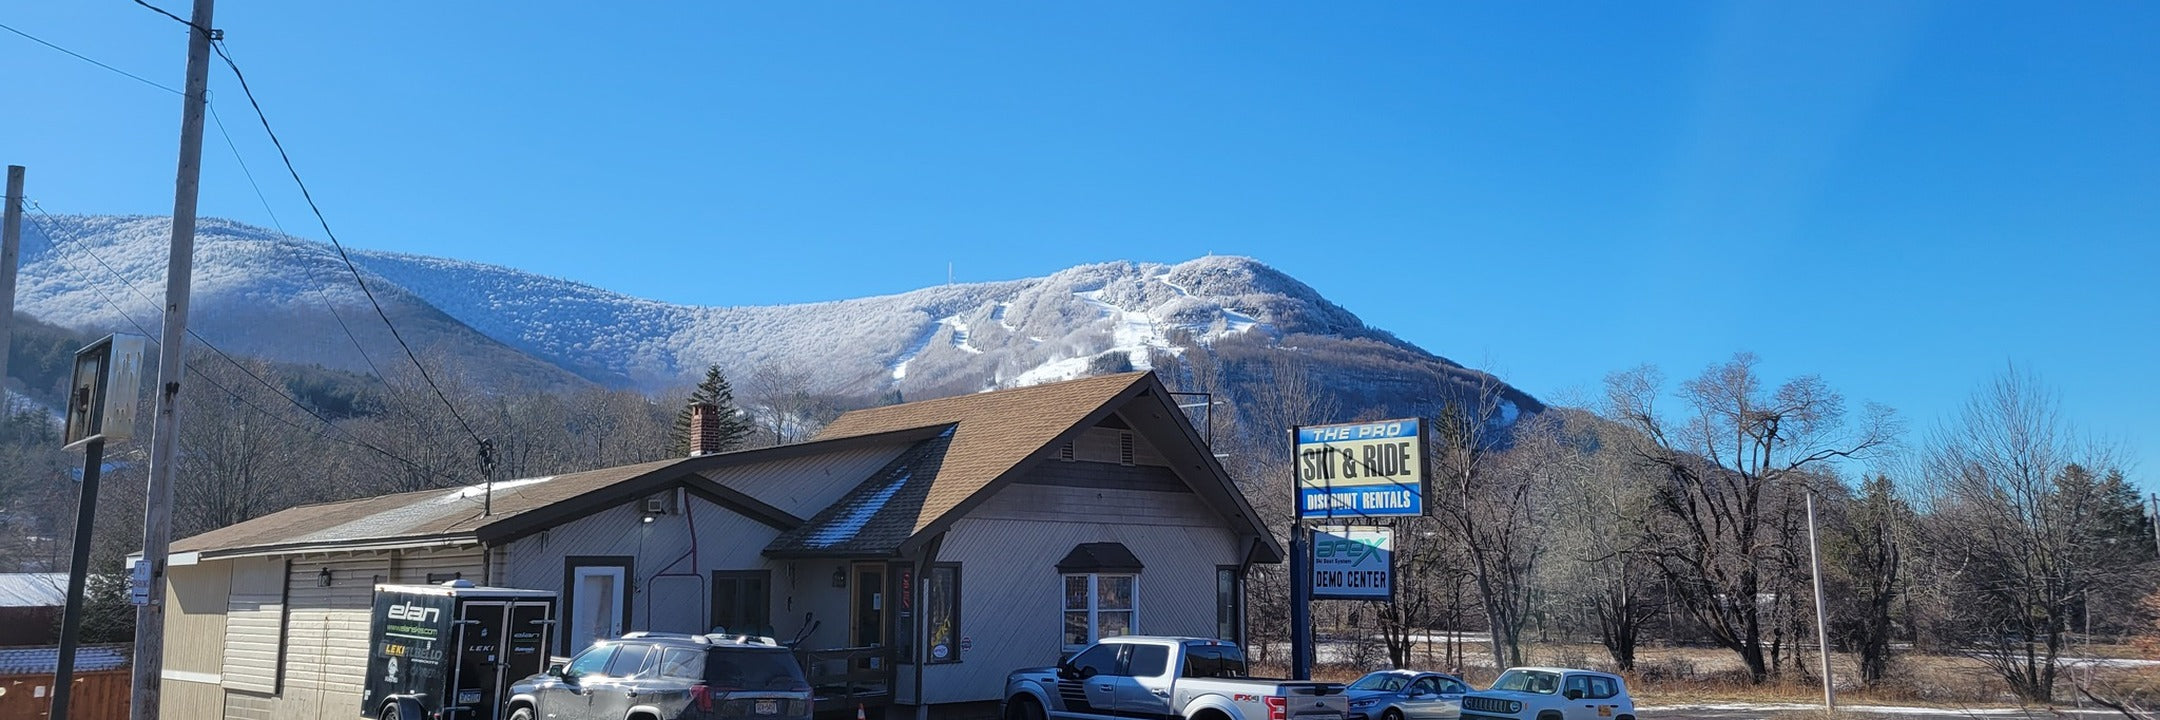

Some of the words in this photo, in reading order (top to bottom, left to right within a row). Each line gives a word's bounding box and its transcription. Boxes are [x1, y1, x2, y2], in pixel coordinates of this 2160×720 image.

[1313, 428, 1351, 442] THE
[1359, 422, 1402, 438] PRO
[1303, 446, 1336, 481] SKI
[1342, 447, 1357, 479] &
[1363, 442, 1411, 477] RIDE
[1307, 492, 1358, 510] DISCOUNT
[1362, 490, 1411, 509] RENTALS
[1316, 571, 1343, 588] DEMO
[1347, 571, 1387, 588] CENTER
[388, 601, 440, 623] elan
[385, 644, 406, 656] LEKI
